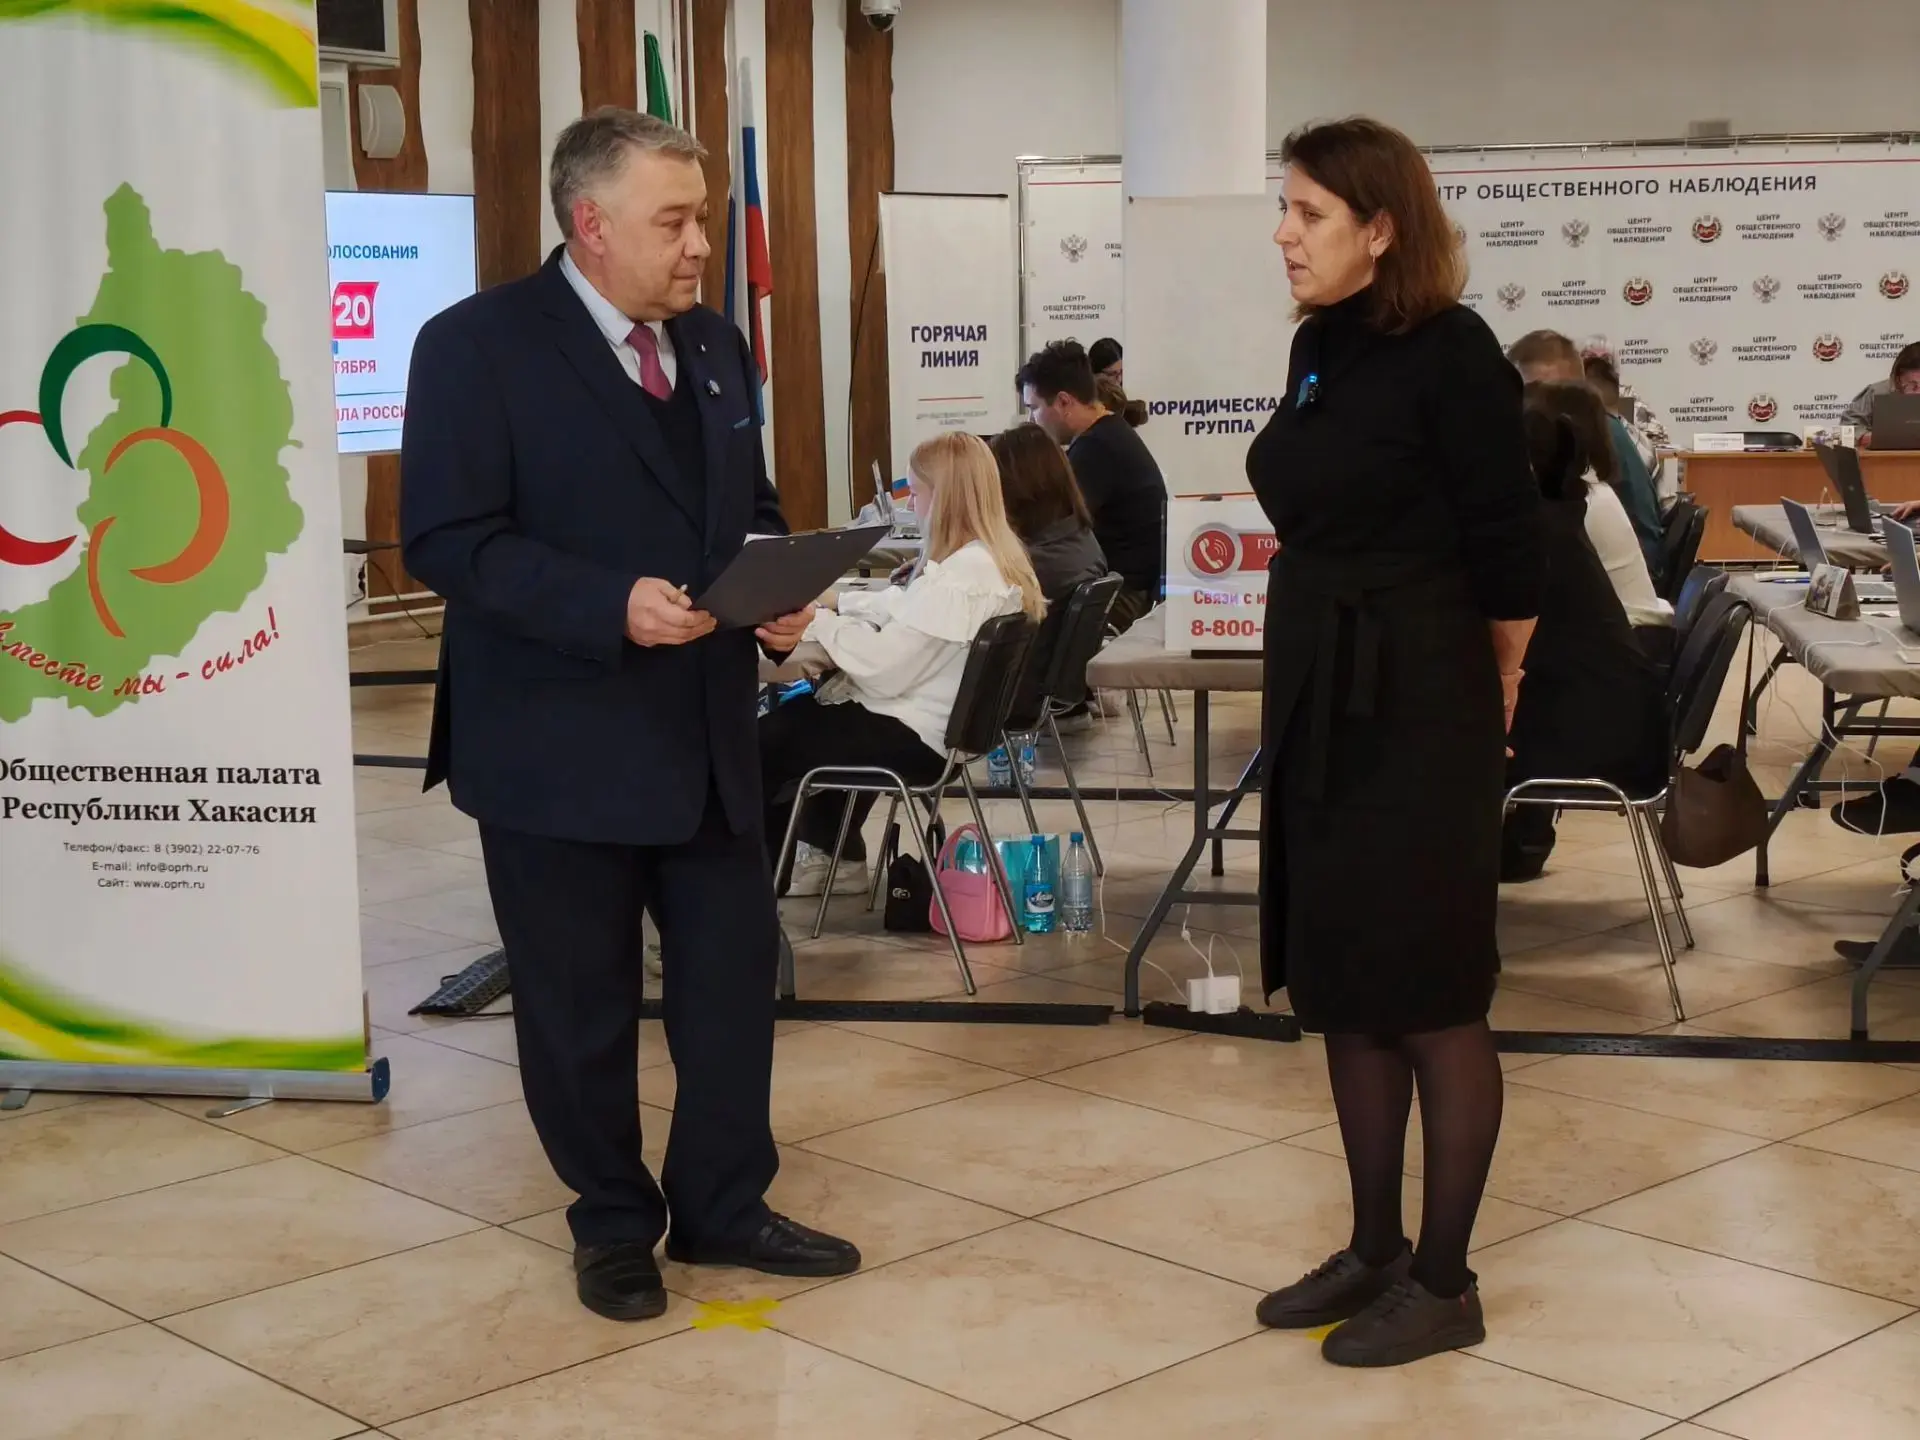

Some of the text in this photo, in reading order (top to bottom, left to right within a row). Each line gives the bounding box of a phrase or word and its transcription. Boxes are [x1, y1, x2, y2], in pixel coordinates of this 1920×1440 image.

[1438, 175, 1817, 202] ТР ОБЩЕСТВЕННОГО НАБЛЮДЕНИЯ
[1756, 214, 1780, 222] ЦЕНТР
[1884, 211, 1909, 219] ЦЕНТР
[1500, 221, 1525, 229] ЦЕНТР
[1627, 217, 1652, 225] ЦЕНТР
[1607, 226, 1672, 234] ОБЩЕСТВЕННОГО
[1735, 222, 1801, 231] ОБЩЕСТВЕННОГО
[1480, 229, 1545, 238] ОБЩЕСТВЕННОГО
[1741, 232, 1794, 240] НАБЛЮДЕНИЯ
[1486, 239, 1538, 247] НАБЛЮДЕНИЯ
[1613, 235, 1665, 243] НАБЛЮДЕНИЯ
[1693, 277, 1718, 285] ЦЕНТР
[1817, 274, 1842, 282] ЦЕНТР
[1562, 280, 1586, 288] ЦЕНТР
[1797, 282, 1862, 291] ОБЩЕСТВЕННОГО
[1541, 288, 1607, 297] ОБЩЕСТВЕННОГО
[1672, 285, 1738, 294] ОБЩЕСТВЕННОГО
[1679, 295, 1731, 303] НАБЛЮДЕНИЯ
[1803, 292, 1856, 300] НАБЛЮДЕНИЯ
[1547, 298, 1600, 306] НАБЛЮДЕНИЯ
[335, 295, 371, 327] 20
[1042, 304, 1106, 312] ОБЩЕСТВЕННОГО
[1049, 313, 1100, 321] НАБЛЮДЕНИЯ
[911, 325, 987, 343] ГОРЯЧАЯ
[1880, 333, 1904, 341] ЦЕНТР
[1624, 339, 1649, 347] ЦЕНТР
[1752, 336, 1777, 344] ЦЕНТР
[1732, 344, 1797, 353] ОБЩЕСТВЕННОГО
[921, 350, 979, 368] ЛИНИЯ
[1738, 354, 1790, 362] НАБЛЮДЕНИЯ
[1690, 397, 1714, 405] ЦЕНТР
[1814, 394, 1838, 402] ЦЕНТР
[1149, 397, 1282, 417] ЮРИДИЧЕСКА
[1669, 405, 1734, 414] ОБЩЕСТВЕННОГО
[1676, 415, 1728, 423] НАБЛЮДЕНИЯ
[1185, 419, 1255, 435] ГРУППА
[1194, 590, 1238, 605] Связи
[1244, 592, 1252, 605] с
[1191, 619, 1262, 637] 8-800-
[114, 675, 166, 696] мы
[201, 606, 280, 680] сила!
[215, 766, 322, 785] палата
[2, 796, 317, 826] Республики Хакасия
[63, 842, 260, 856] Телефон/факс: 8 (3902) 22-07-76
[92, 862, 209, 874] E-mail: info@oprh.ru
[97, 878, 205, 891] Сайт: www.oprh.ru
